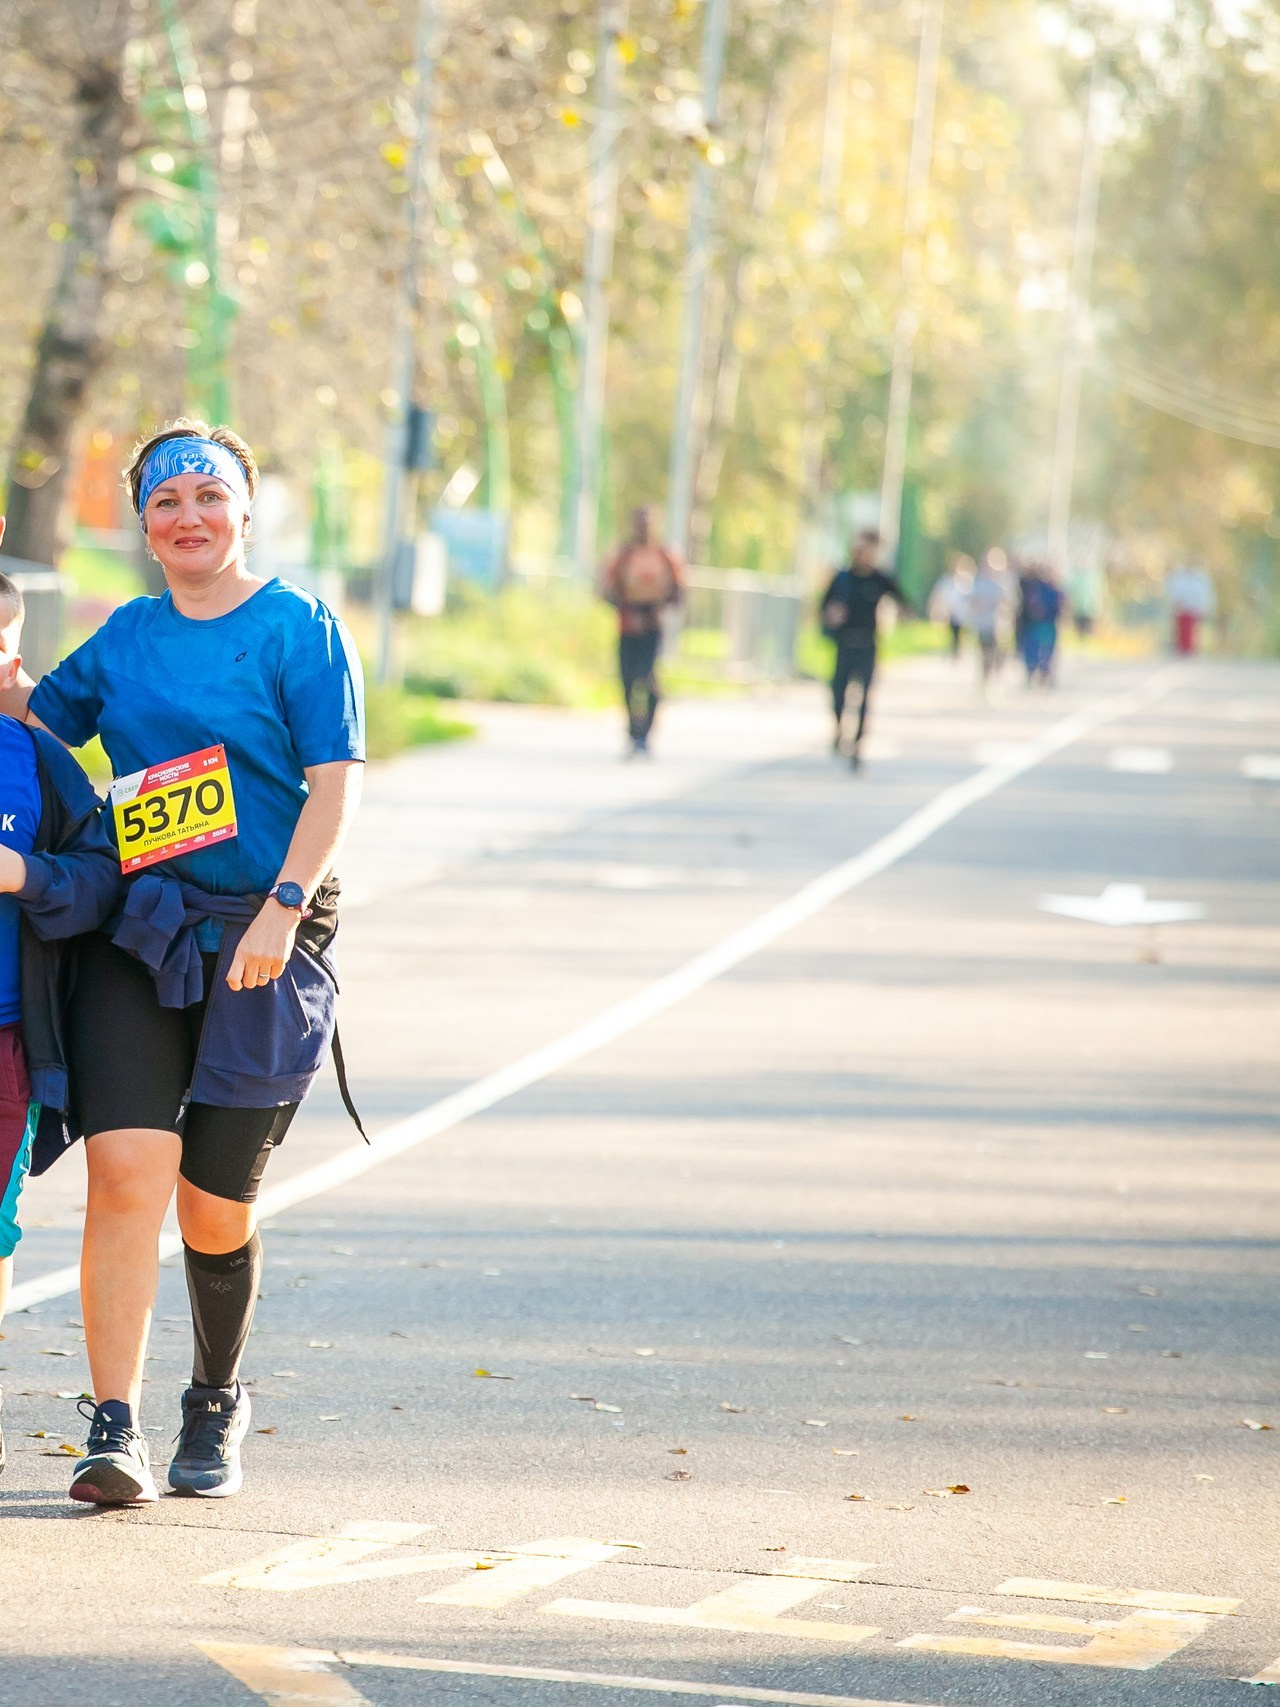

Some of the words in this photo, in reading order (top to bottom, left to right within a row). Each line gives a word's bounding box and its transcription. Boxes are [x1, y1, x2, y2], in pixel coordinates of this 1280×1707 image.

[159, 771, 180, 782] МОСТЫ
[122, 779, 225, 843] 5370
[143, 831, 177, 847] ПУЧКОВА
[177, 820, 210, 835] ТАТЬЯНА
[194, 1521, 1280, 1686] ЕТИ
